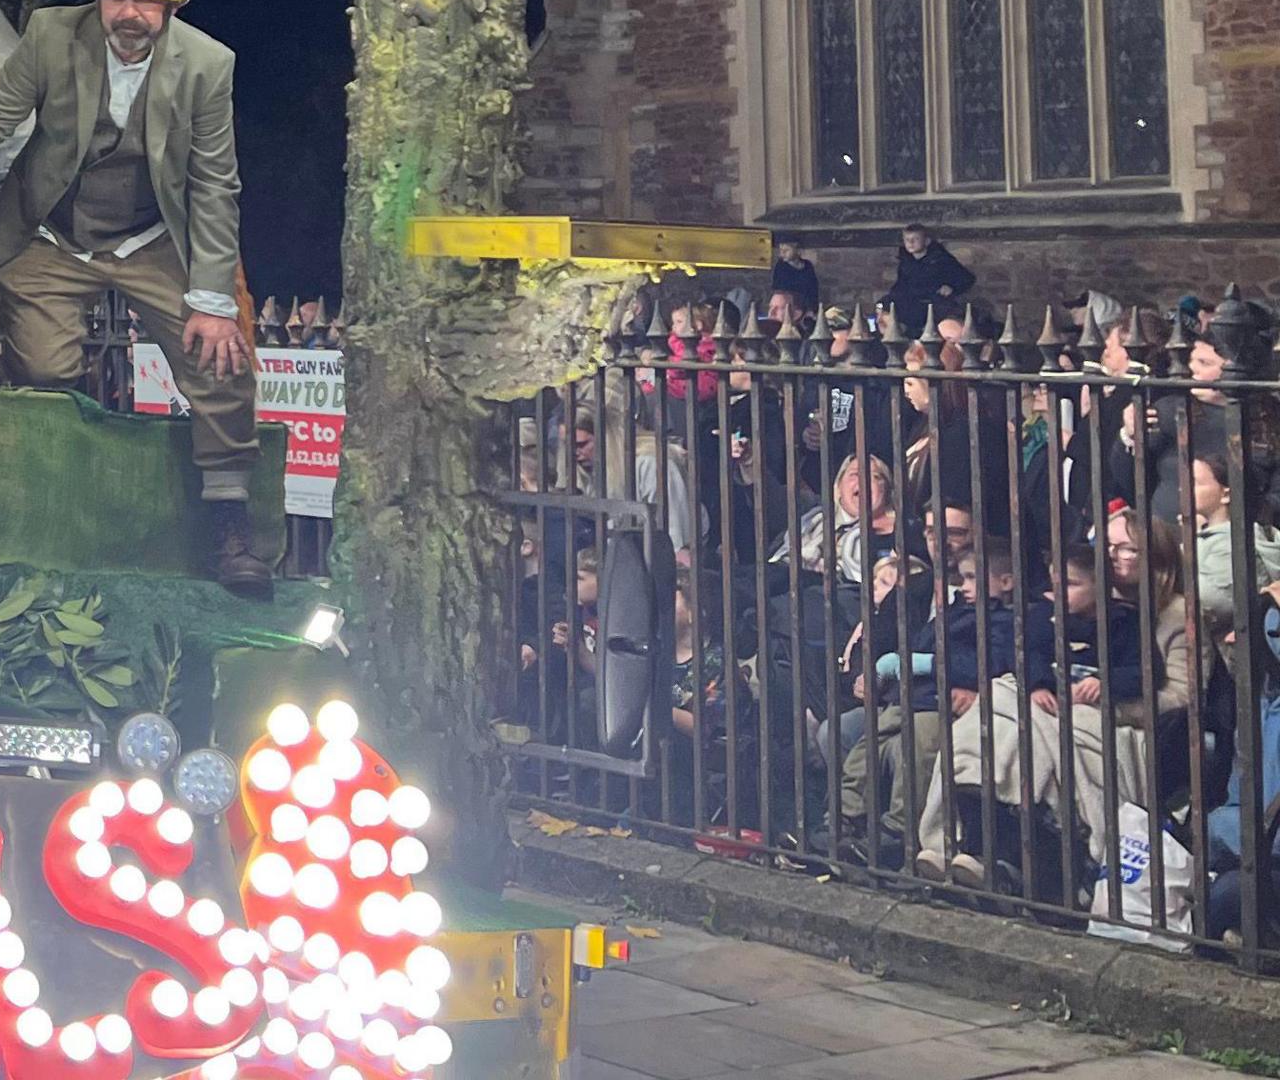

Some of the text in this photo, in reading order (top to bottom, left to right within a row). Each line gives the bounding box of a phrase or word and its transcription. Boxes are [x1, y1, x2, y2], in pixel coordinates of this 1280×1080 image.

[296, 359, 318, 375] GUY
[261, 380, 302, 405] WAY
[304, 381, 329, 408] TO
[312, 421, 337, 443] to
